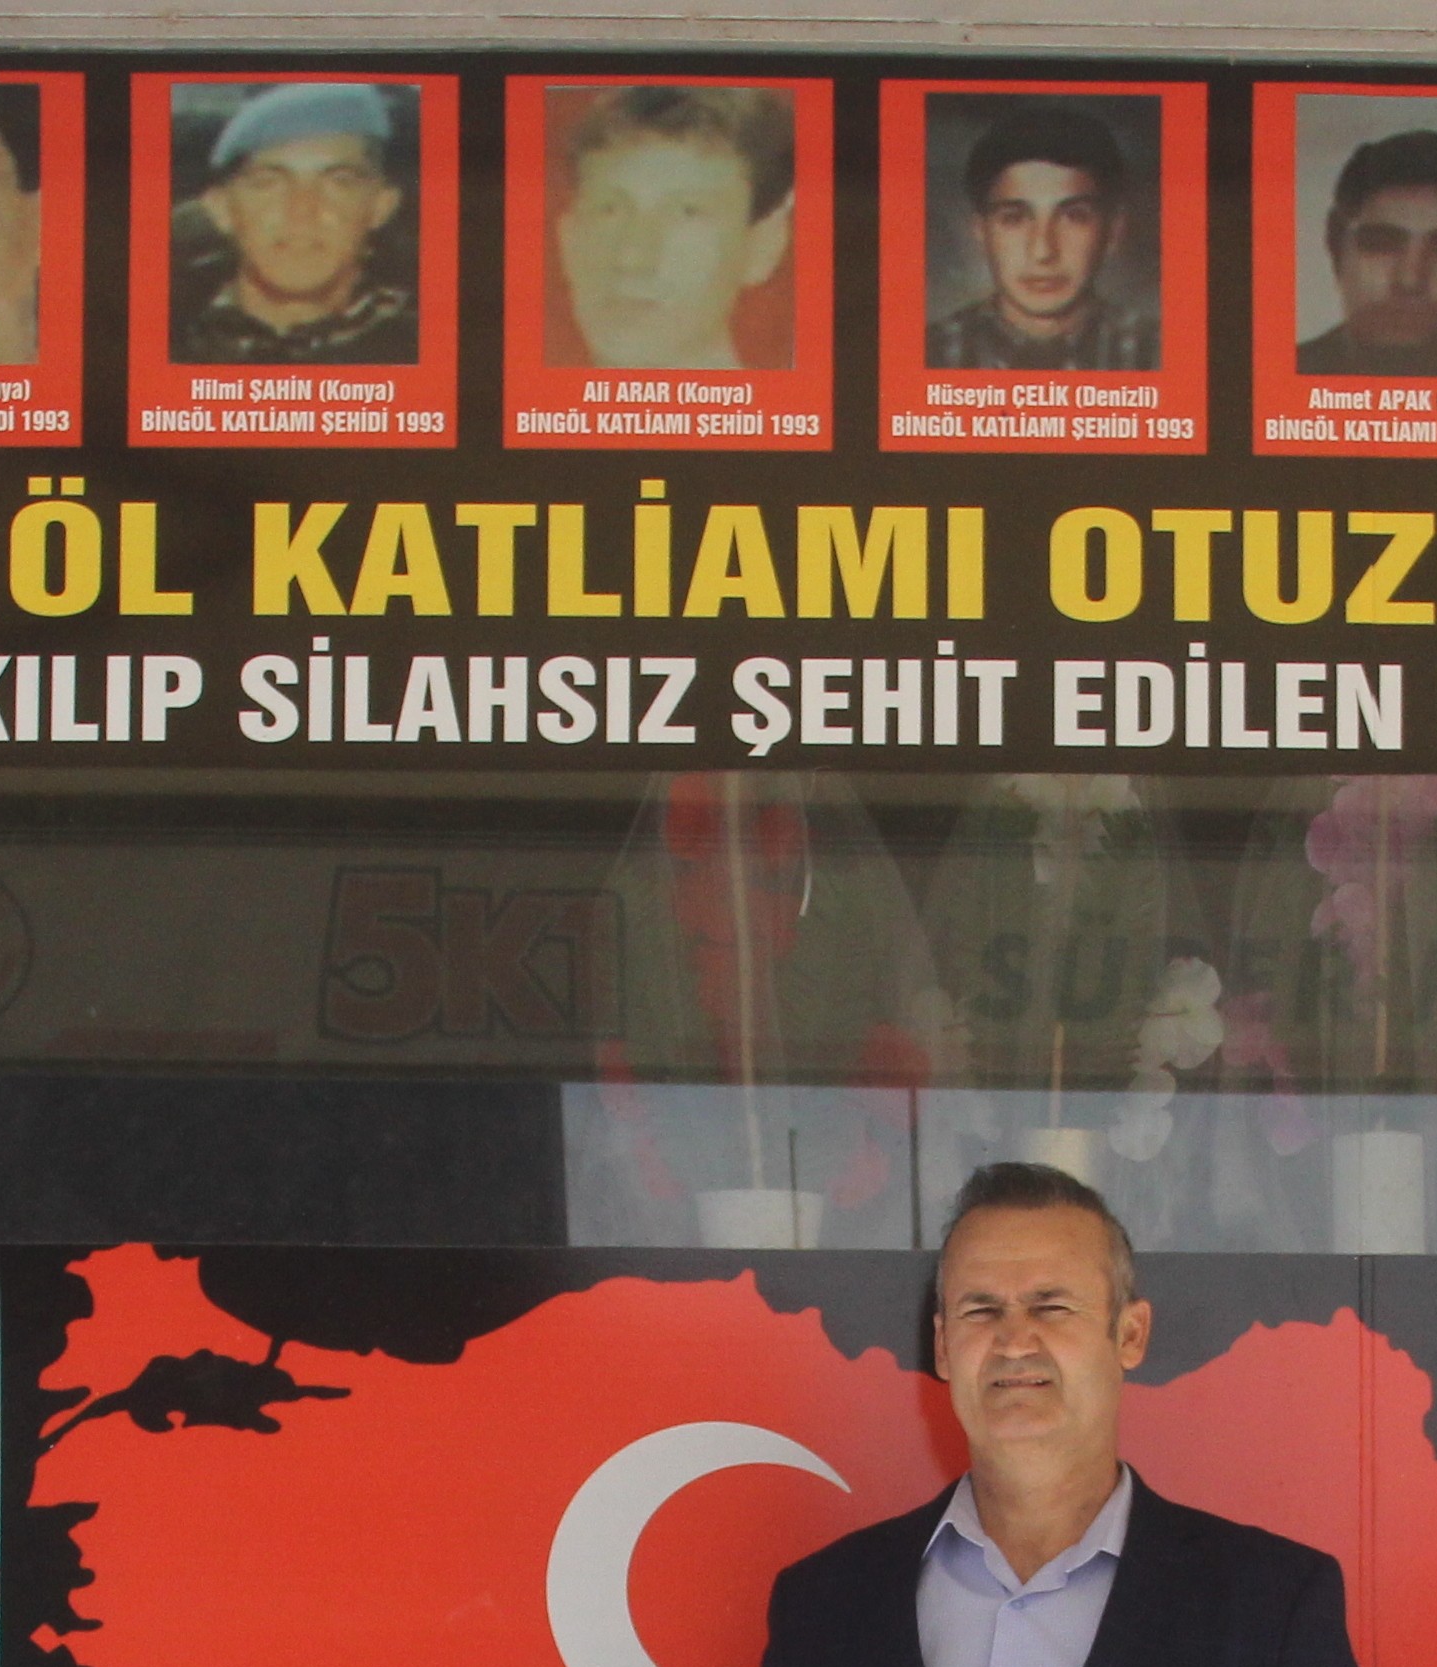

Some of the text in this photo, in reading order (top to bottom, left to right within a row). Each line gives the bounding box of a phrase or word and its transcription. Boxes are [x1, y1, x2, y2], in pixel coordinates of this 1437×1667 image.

[191, 375, 395, 404] Hilmi ŞAHİN (Konya)
[583, 380, 753, 407] Ali ARAR (Konya)
[926, 381, 1159, 409] Hüseyin ÇELİK (Denizli)
[1308, 387, 1373, 410] Ahmet
[1378, 389, 1432, 411] APAK
[253, 479, 984, 620] KATLİAMI
[238, 636, 697, 744] SİLAHSIZ
[731, 640, 1018, 757] ŞEHİT
[1053, 642, 1403, 750] EDİLEN
